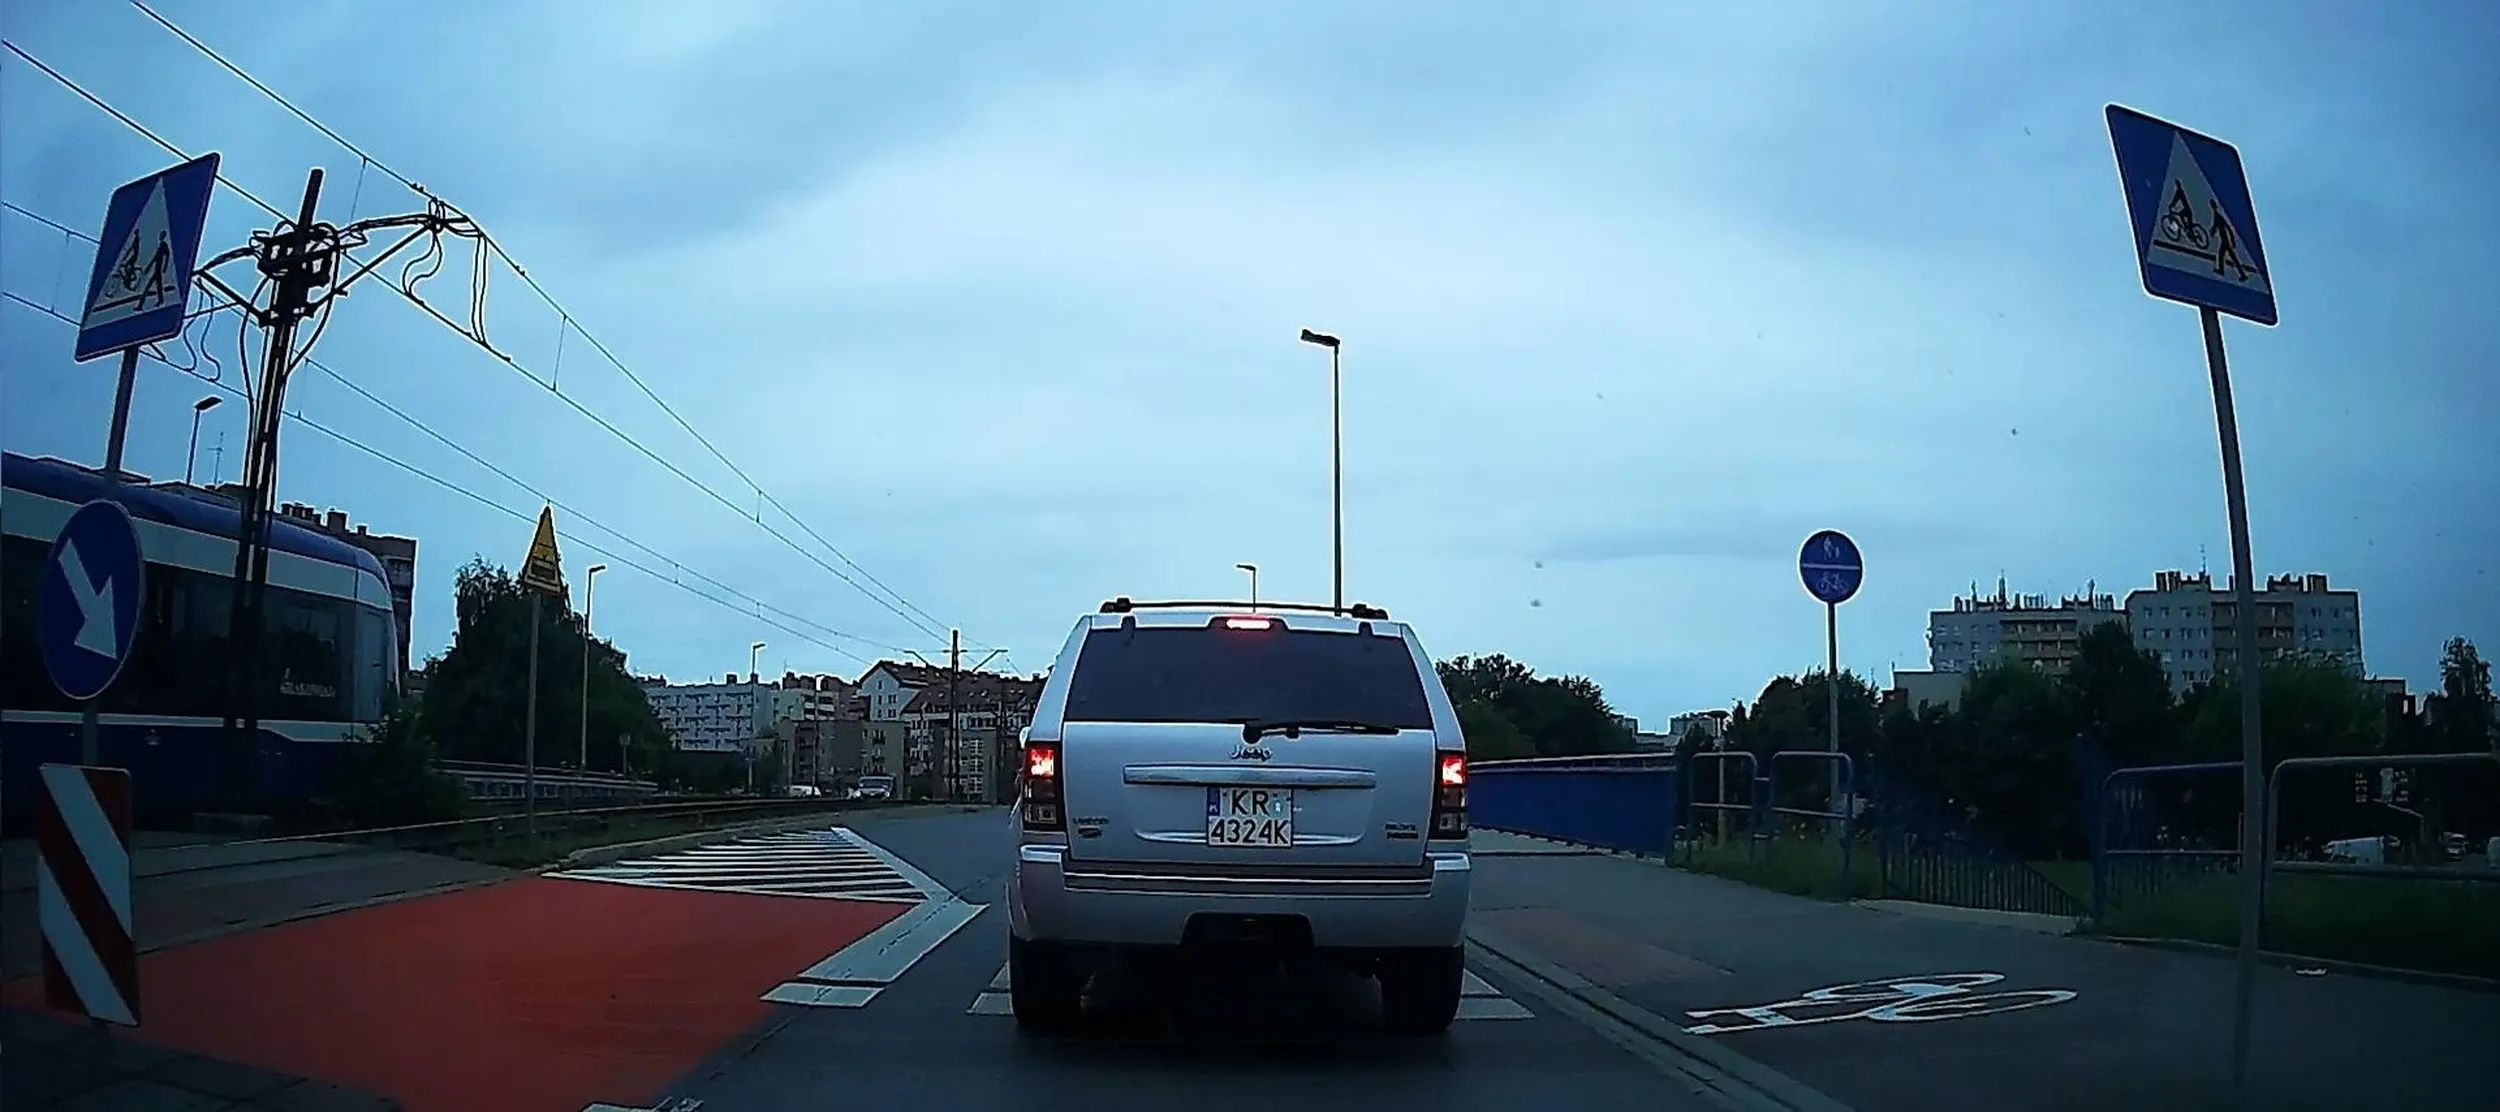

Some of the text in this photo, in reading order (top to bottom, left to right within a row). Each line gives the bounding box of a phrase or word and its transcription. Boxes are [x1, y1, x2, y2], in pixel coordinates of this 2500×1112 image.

[1229, 744, 1272, 762] Jeep
[1231, 789, 1269, 815] KR
[1211, 819, 1289, 844] 4324K
